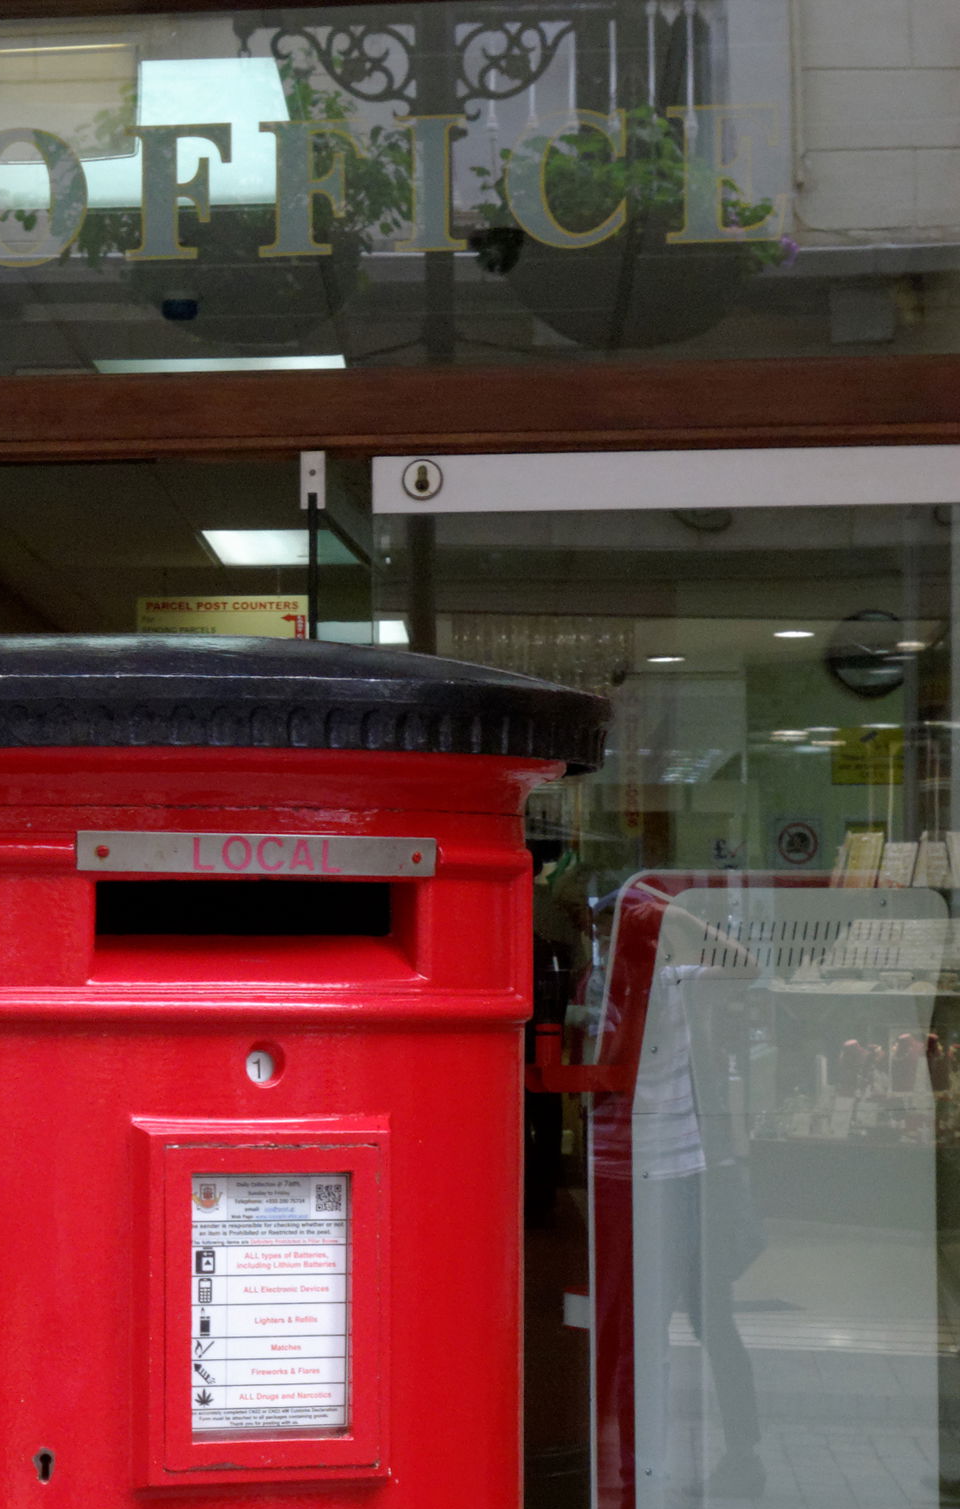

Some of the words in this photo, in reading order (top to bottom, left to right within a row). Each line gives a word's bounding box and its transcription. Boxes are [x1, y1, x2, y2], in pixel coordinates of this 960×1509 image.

[146, 601, 193, 611] PARCEL
[197, 601, 228, 611] POST
[232, 601, 299, 611] COUNTERS
[191, 836, 342, 873] LOCAL
[252, 1058, 261, 1079] 1
[261, 1252, 282, 1261] types
[273, 1261, 301, 1269] Lithium
[303, 1261, 336, 1269] Batteries
[261, 1285, 298, 1293] Electronic
[254, 1316, 285, 1325] Lighters
[251, 1367, 288, 1376] Fireworks
[298, 1367, 320, 1375] Flares
[239, 1393, 254, 1401] ALL
[256, 1393, 278, 1401] Drugs
